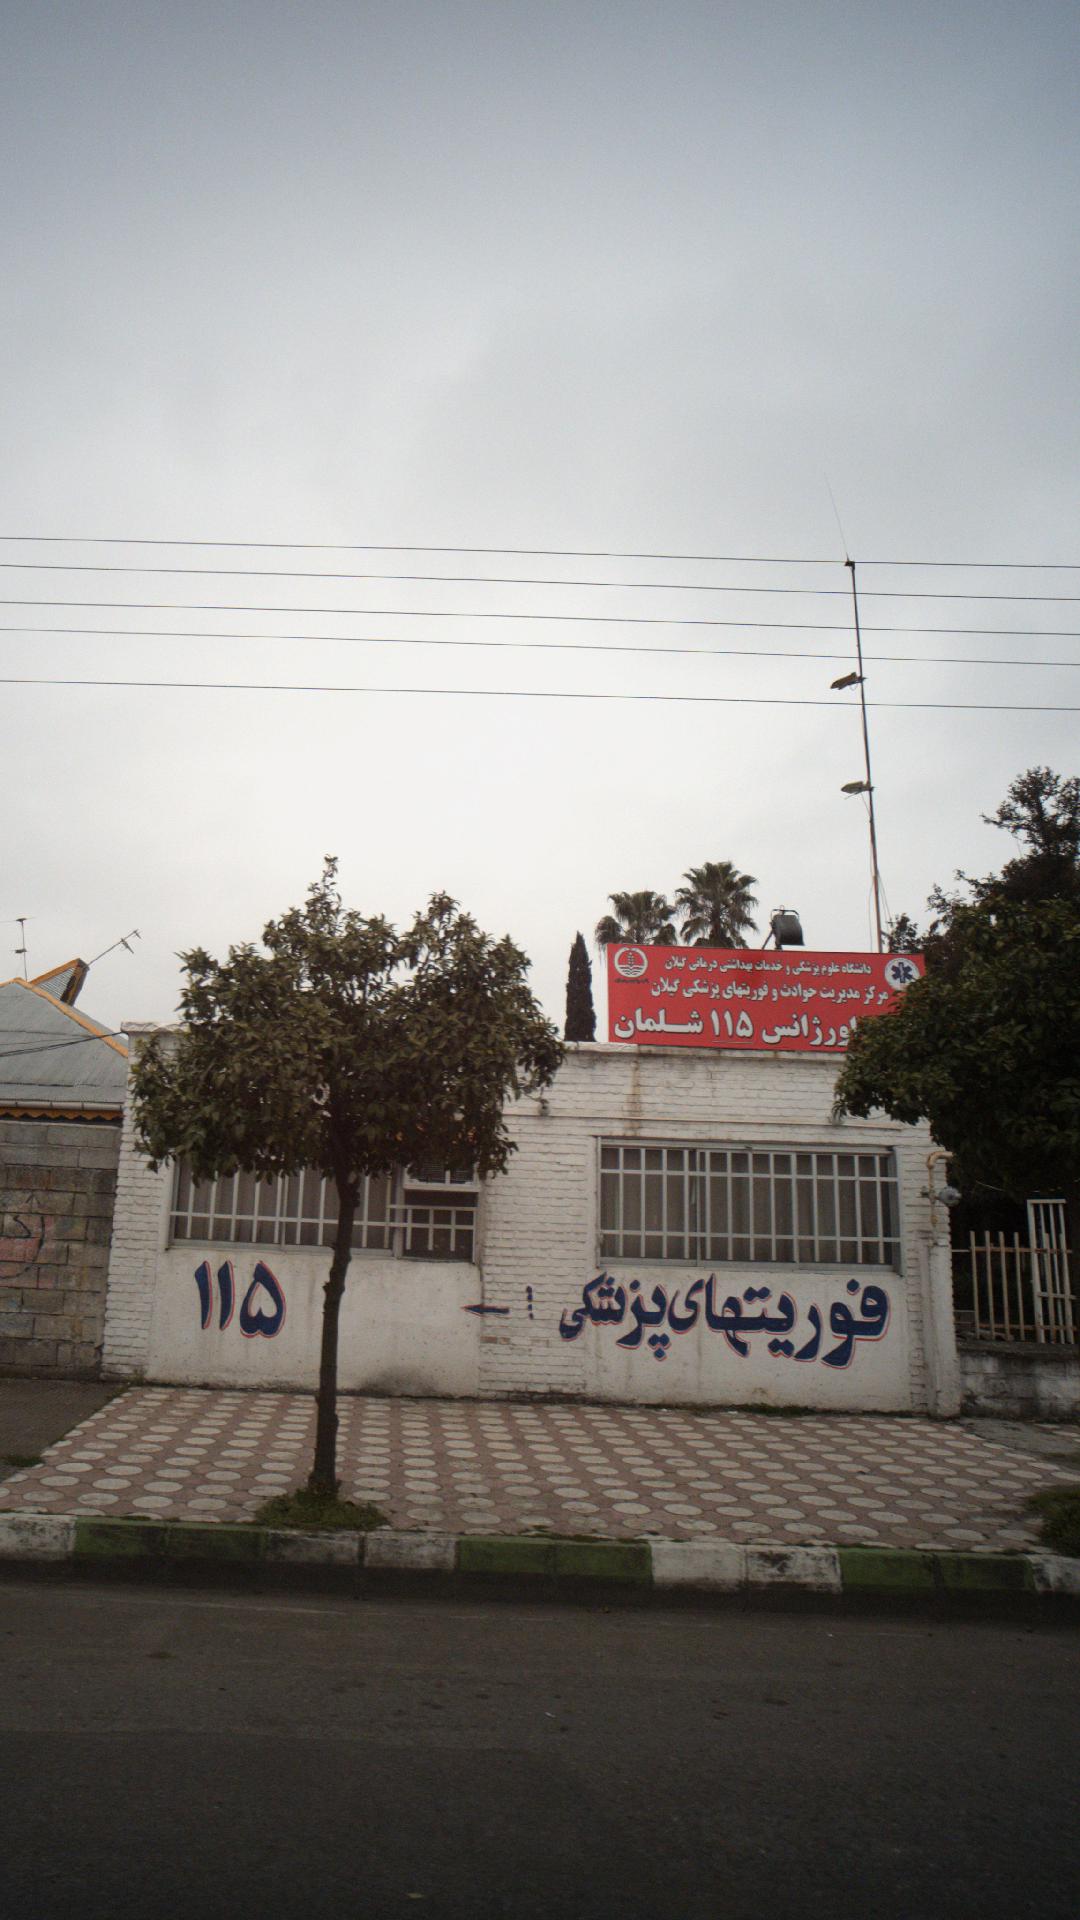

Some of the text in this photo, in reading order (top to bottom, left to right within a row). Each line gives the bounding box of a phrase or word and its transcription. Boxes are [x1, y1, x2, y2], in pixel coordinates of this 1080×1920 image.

[665, 954, 872, 977] دانشگاه علوم پزشکی و خدمات بهداشتی درمانی گیلان
[651, 976, 681, 997] گیلان
[682, 978, 720, 999] پزشکی
[772, 988, 779, 1001] و
[780, 983, 817, 1003] حوادث
[819, 986, 861, 1004] مدیریت
[863, 985, 889, 1005] مرکز
[710, 1009, 754, 1038] ۱۱۵
[194, 1260, 287, 1339] ۱۱۵
[558, 1271, 669, 1362] پزشکی
